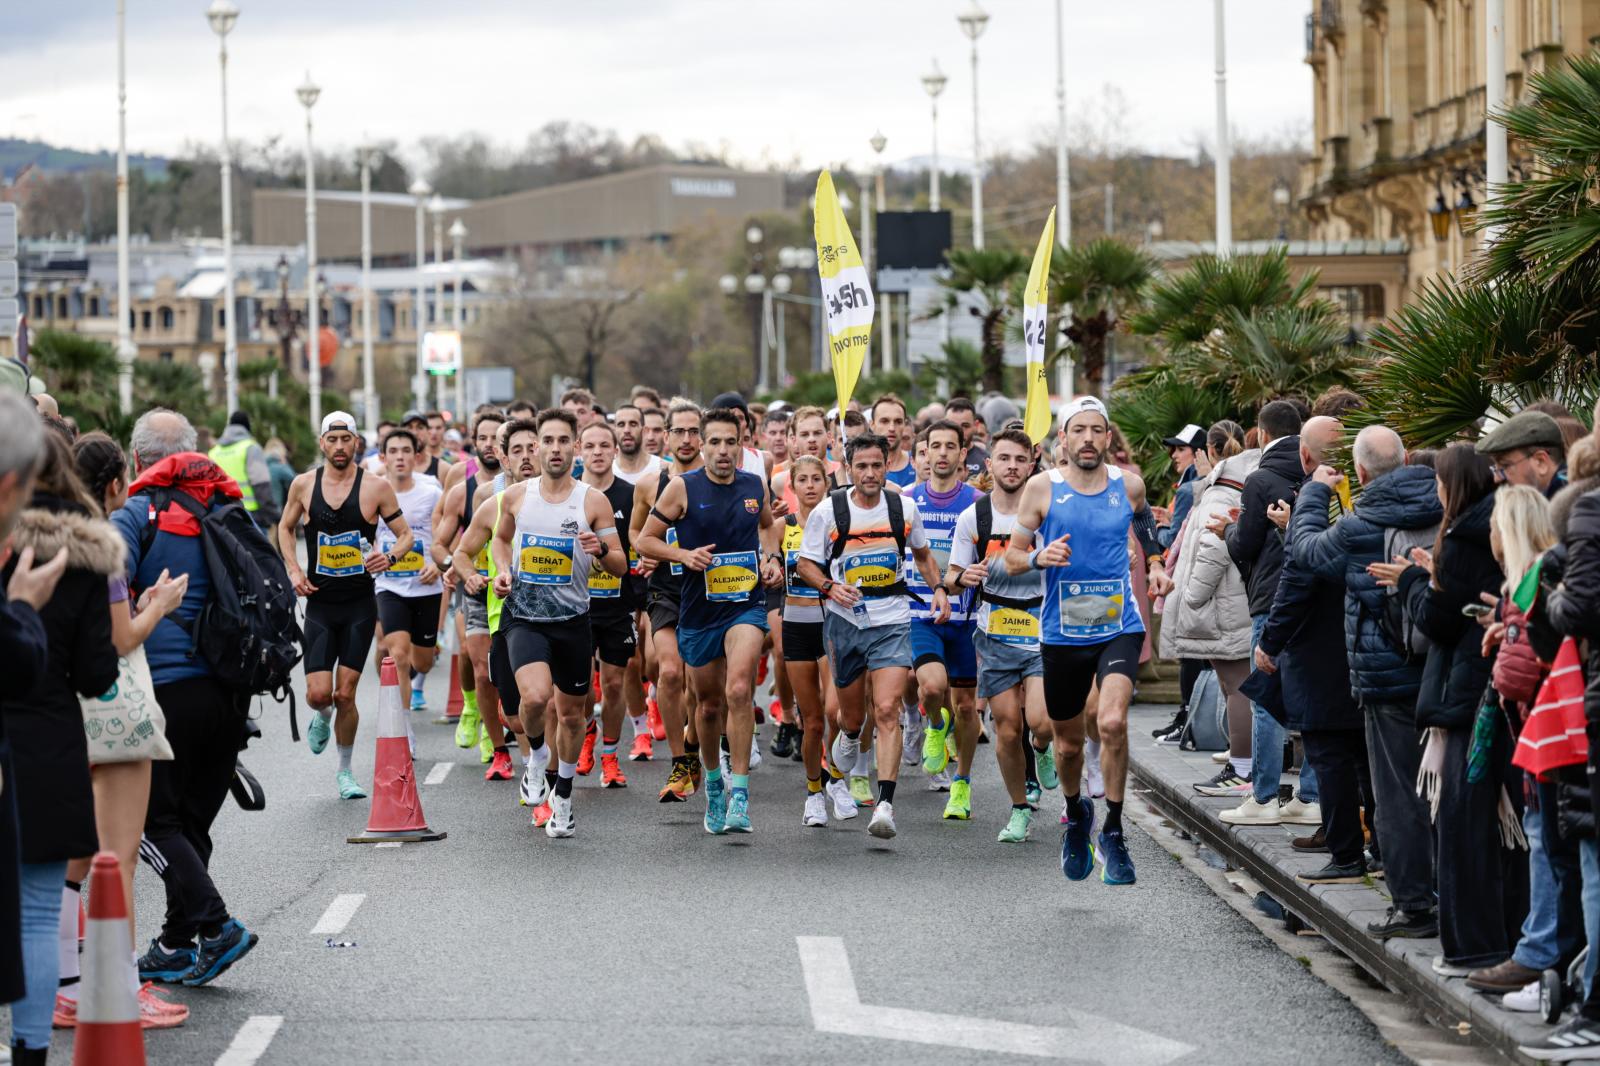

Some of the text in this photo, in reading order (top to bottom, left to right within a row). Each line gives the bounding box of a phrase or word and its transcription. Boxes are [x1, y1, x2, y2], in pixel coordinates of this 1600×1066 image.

[331, 536, 353, 545] ZURICH
[538, 539, 566, 547] ZURICH
[933, 541, 954, 549] ZURIC
[326, 551, 357, 560] IMANOL
[724, 556, 749, 564] ZURICH
[863, 555, 889, 564] ZURICH
[532, 556, 564, 565] BEÑAT
[712, 574, 756, 584] ALEJANDRO
[1083, 585, 1114, 593] ZURICH
[1002, 617, 1031, 626] JAIME
